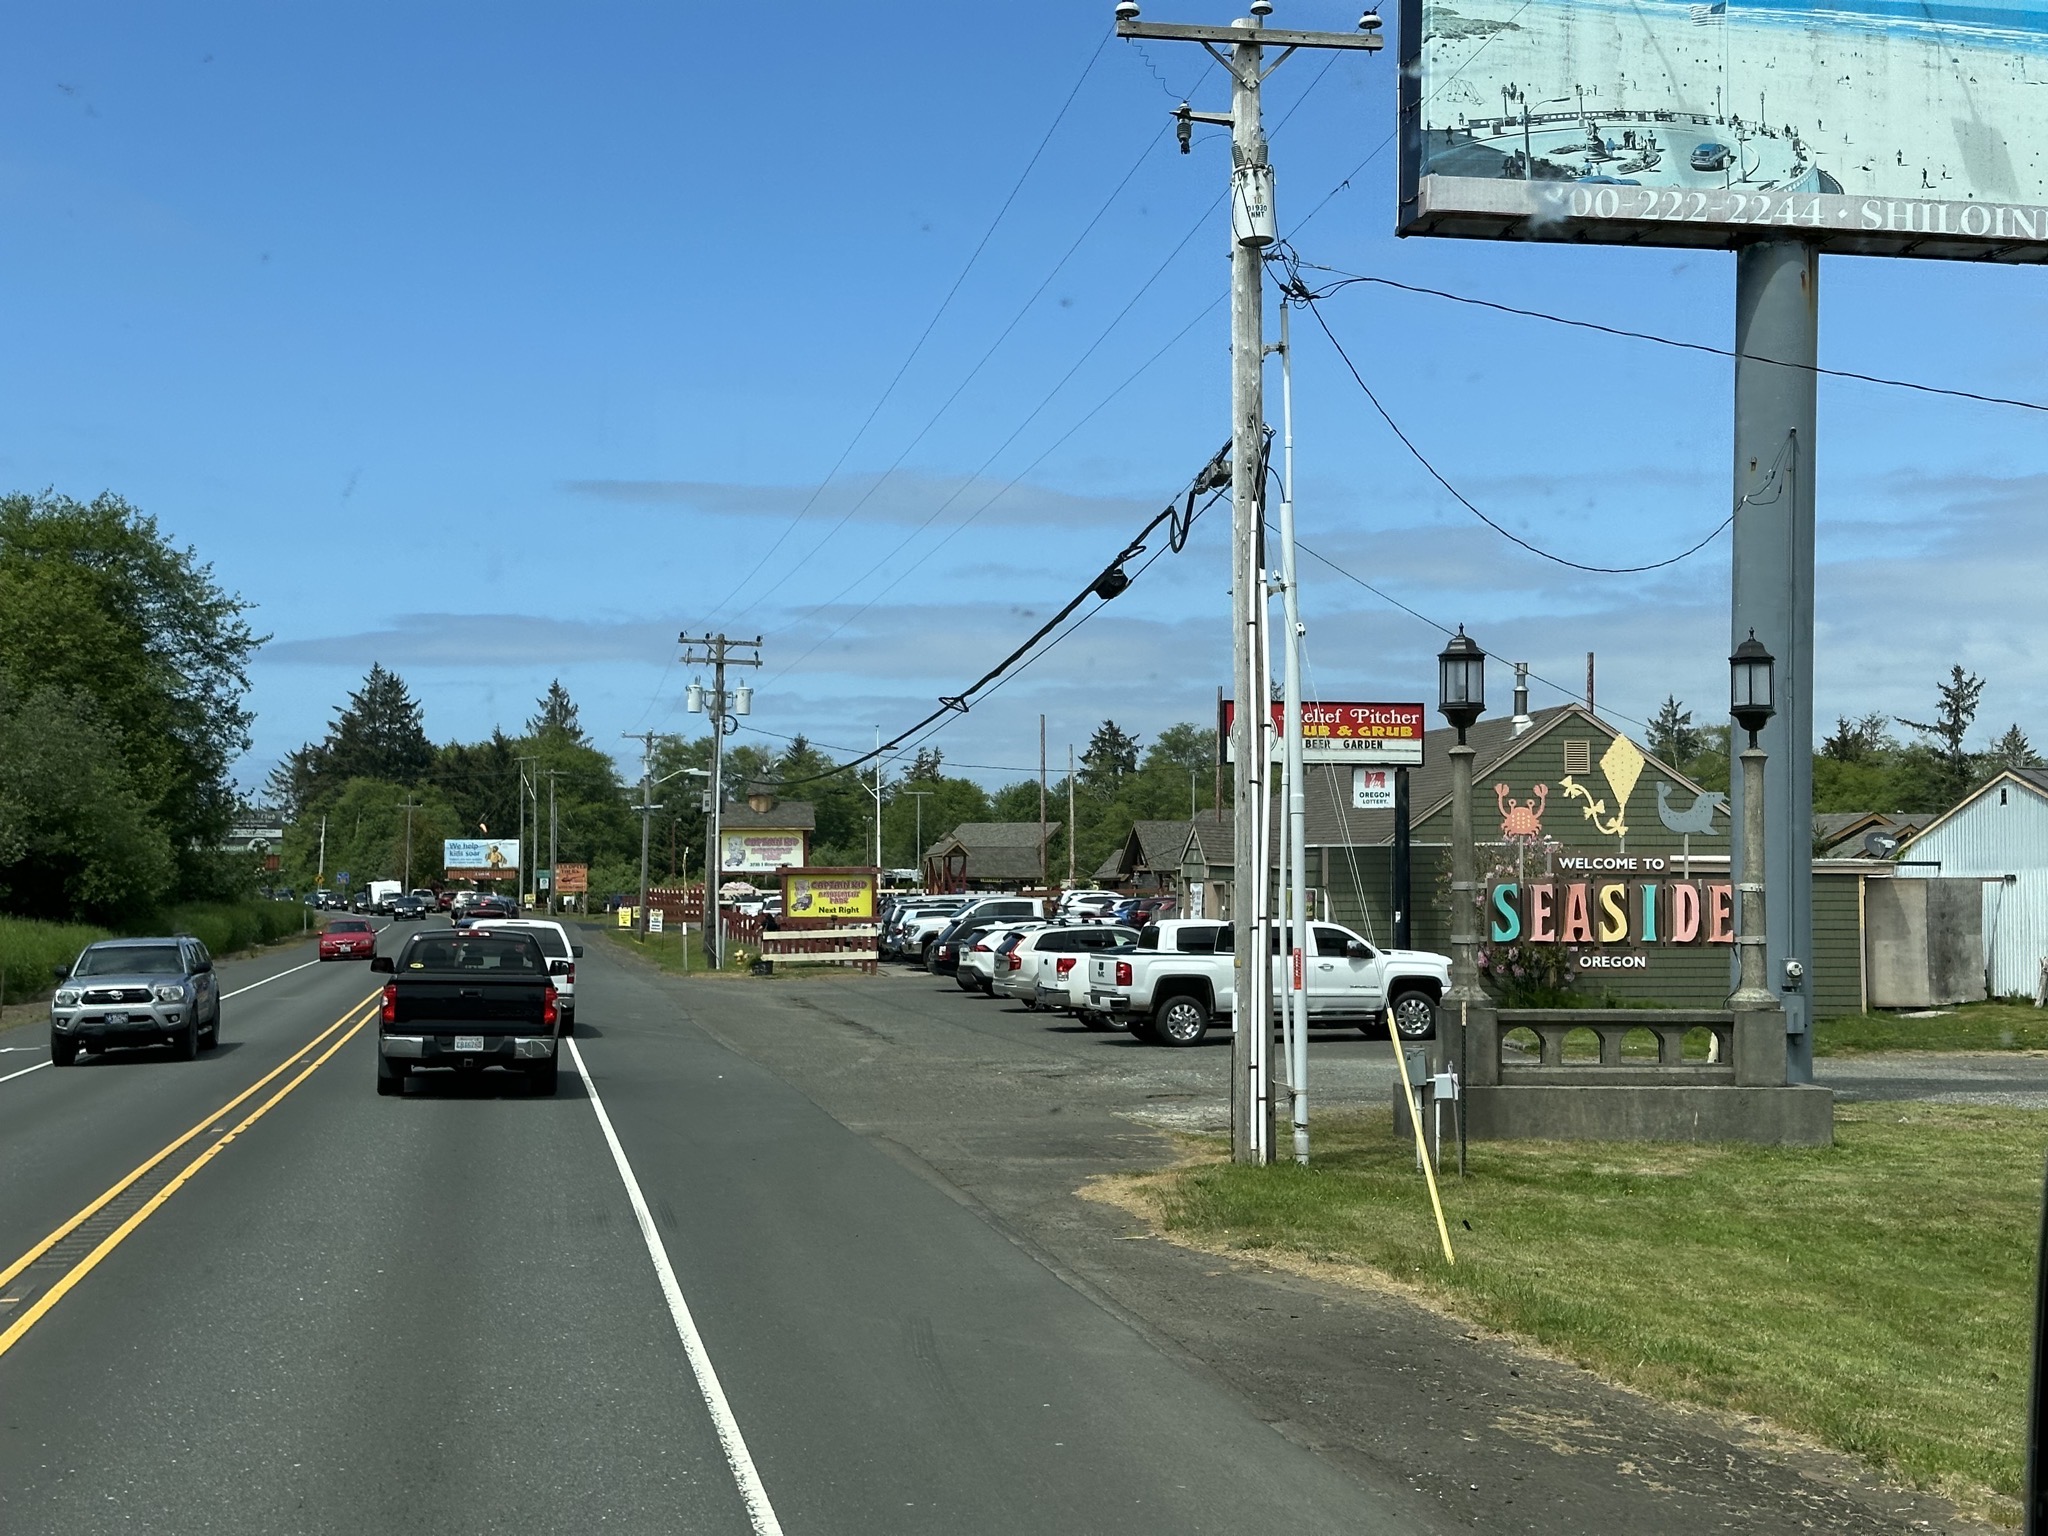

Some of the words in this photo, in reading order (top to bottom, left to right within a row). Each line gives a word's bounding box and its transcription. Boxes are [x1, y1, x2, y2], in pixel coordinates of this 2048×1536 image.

[1861, 199, 2048, 240] SHILOIN
[1350, 709, 1420, 724] Pitcher
[1302, 725, 1331, 737] UB
[1337, 726, 1352, 736] &
[1358, 725, 1413, 737] GRUB
[1305, 739, 1331, 749] BEER
[1343, 739, 1383, 750] GARDEN
[1359, 791, 1391, 799] OREGON
[1558, 857, 1638, 870] WELCOME
[1643, 857, 1665, 870] TO
[811, 880, 850, 890] CAPTAIN
[818, 906, 837, 914] Next
[838, 906, 860, 915] Right
[1490, 882, 1735, 943] SEASIDE
[1579, 955, 1647, 969] OREGON
